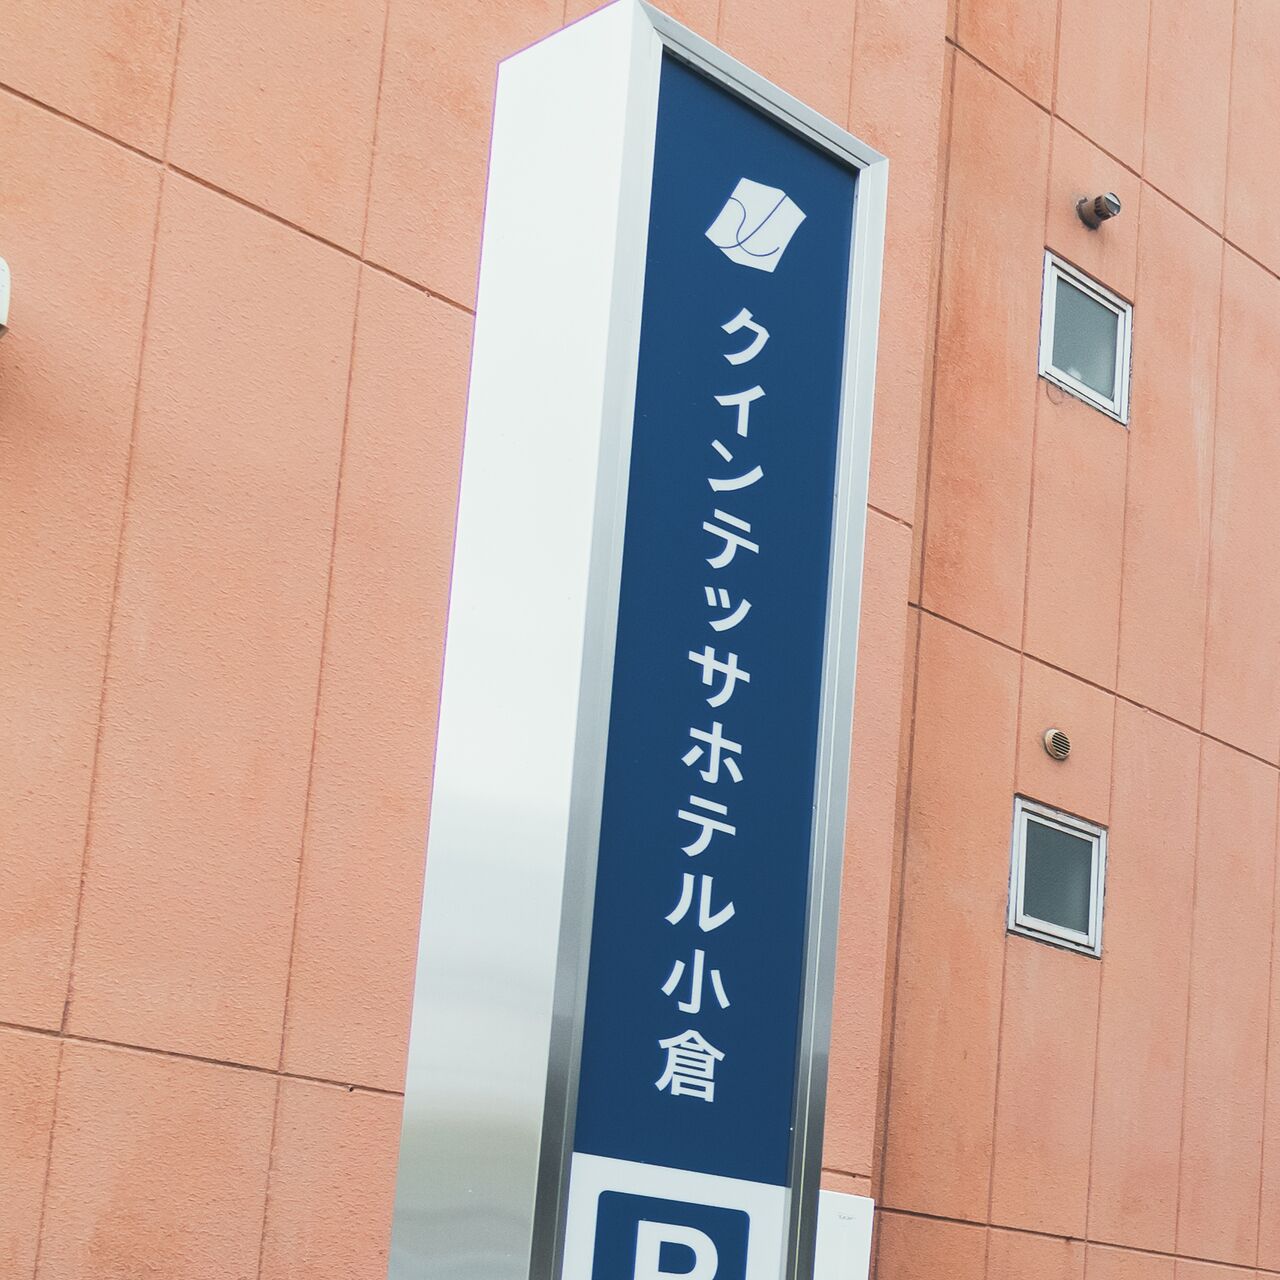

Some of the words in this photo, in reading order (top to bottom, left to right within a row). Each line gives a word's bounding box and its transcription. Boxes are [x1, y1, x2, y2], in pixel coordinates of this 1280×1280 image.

[654, 307, 771, 1103] クインテッサホテル小倉
